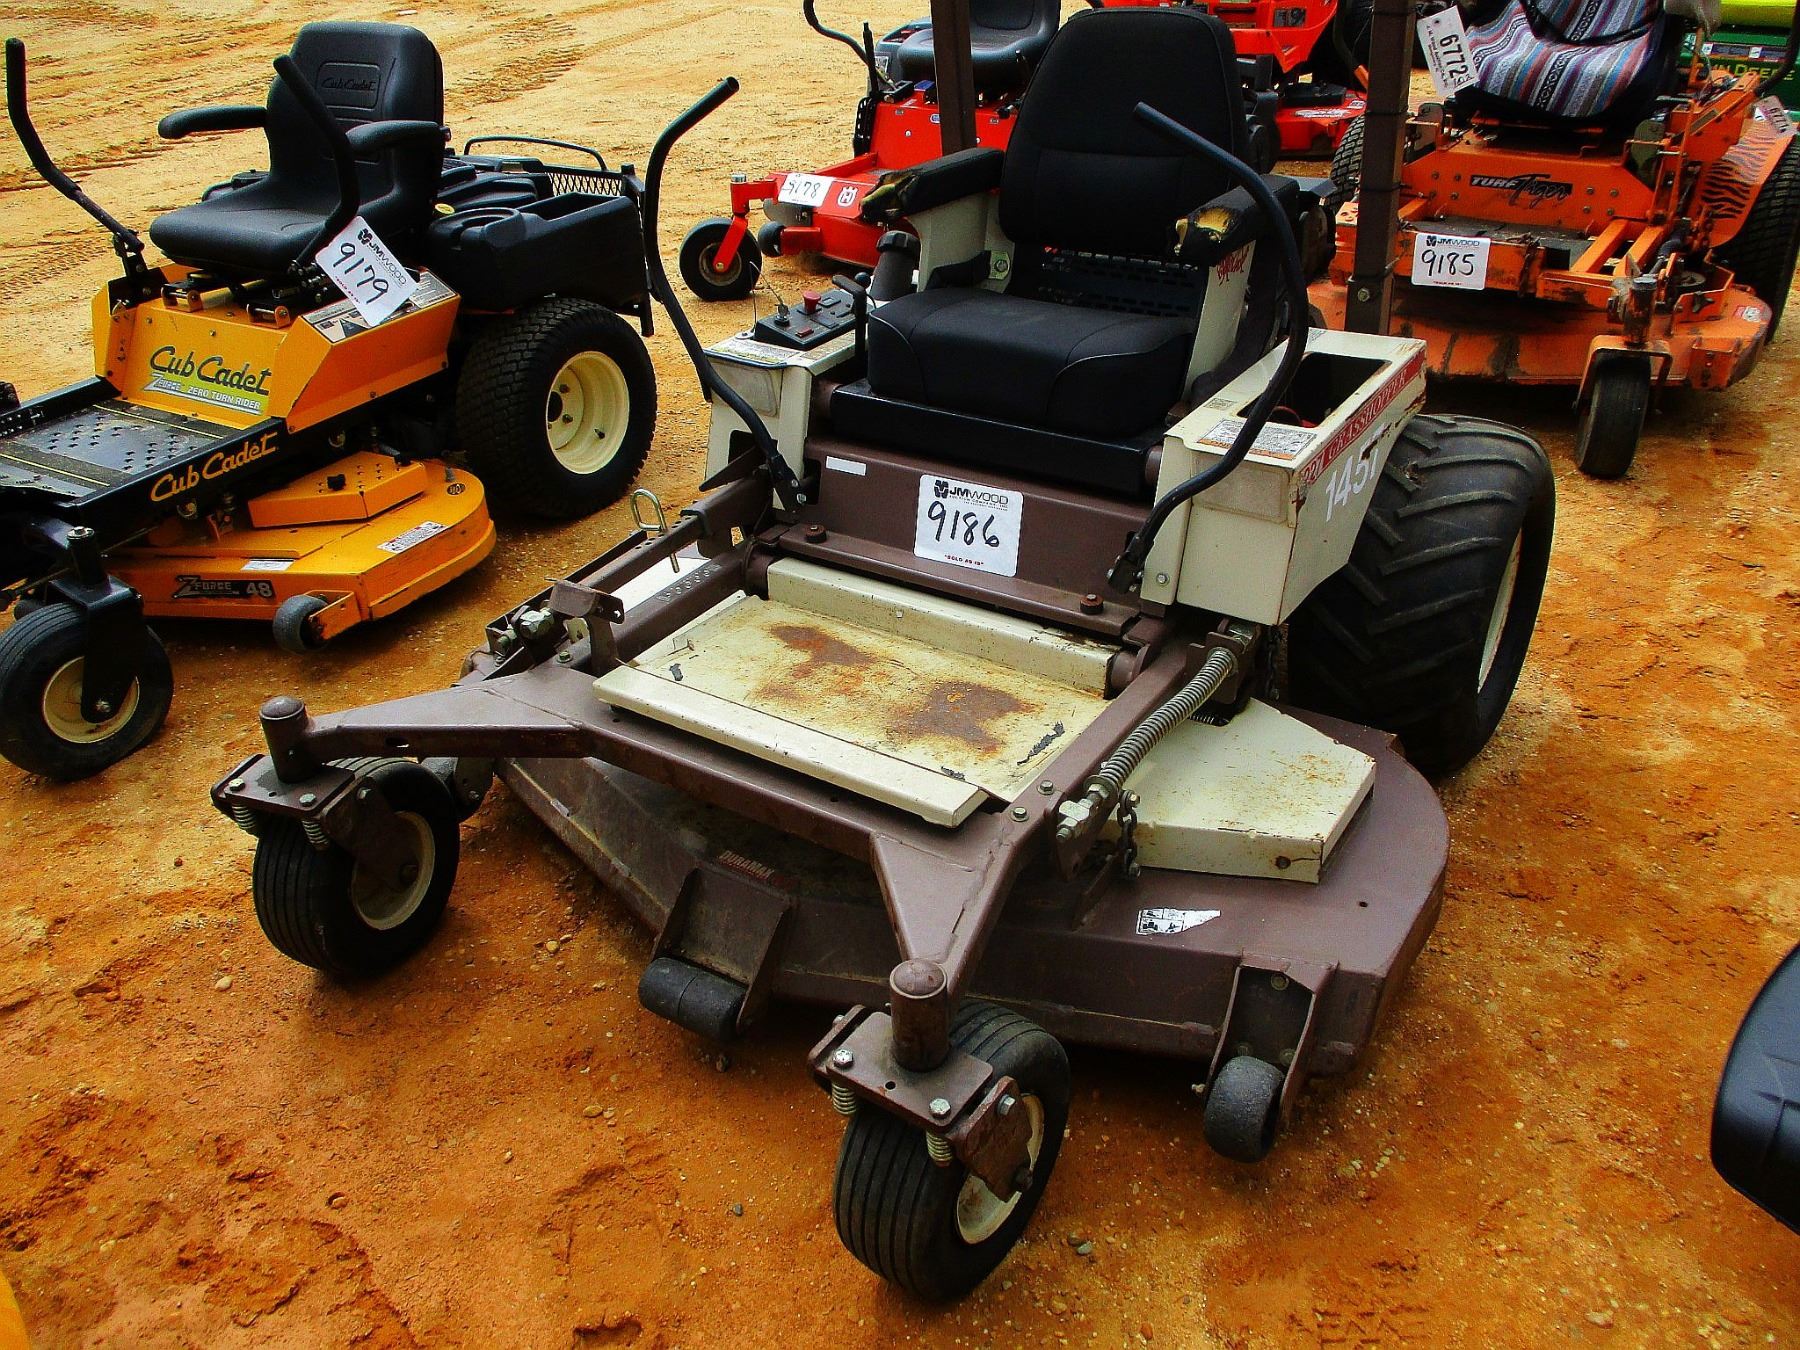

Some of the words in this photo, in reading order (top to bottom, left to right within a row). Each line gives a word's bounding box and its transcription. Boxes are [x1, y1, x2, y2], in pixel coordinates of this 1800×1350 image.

[1440, 34, 1468, 79] 6772
[1471, 176, 1519, 189] TURF
[333, 242, 388, 304] 9179
[1421, 249, 1475, 276] 9185
[150, 346, 195, 377] Cub
[197, 356, 272, 396] Cadet
[187, 386, 209, 398] ZERO
[211, 391, 234, 405] TURN
[235, 398, 261, 409] RIDER
[150, 464, 200, 502] Cub
[202, 431, 278, 480] Cadet
[950, 487, 1009, 505] JMWOOD
[928, 500, 1000, 548] 9186
[246, 582, 273, 598] 48
